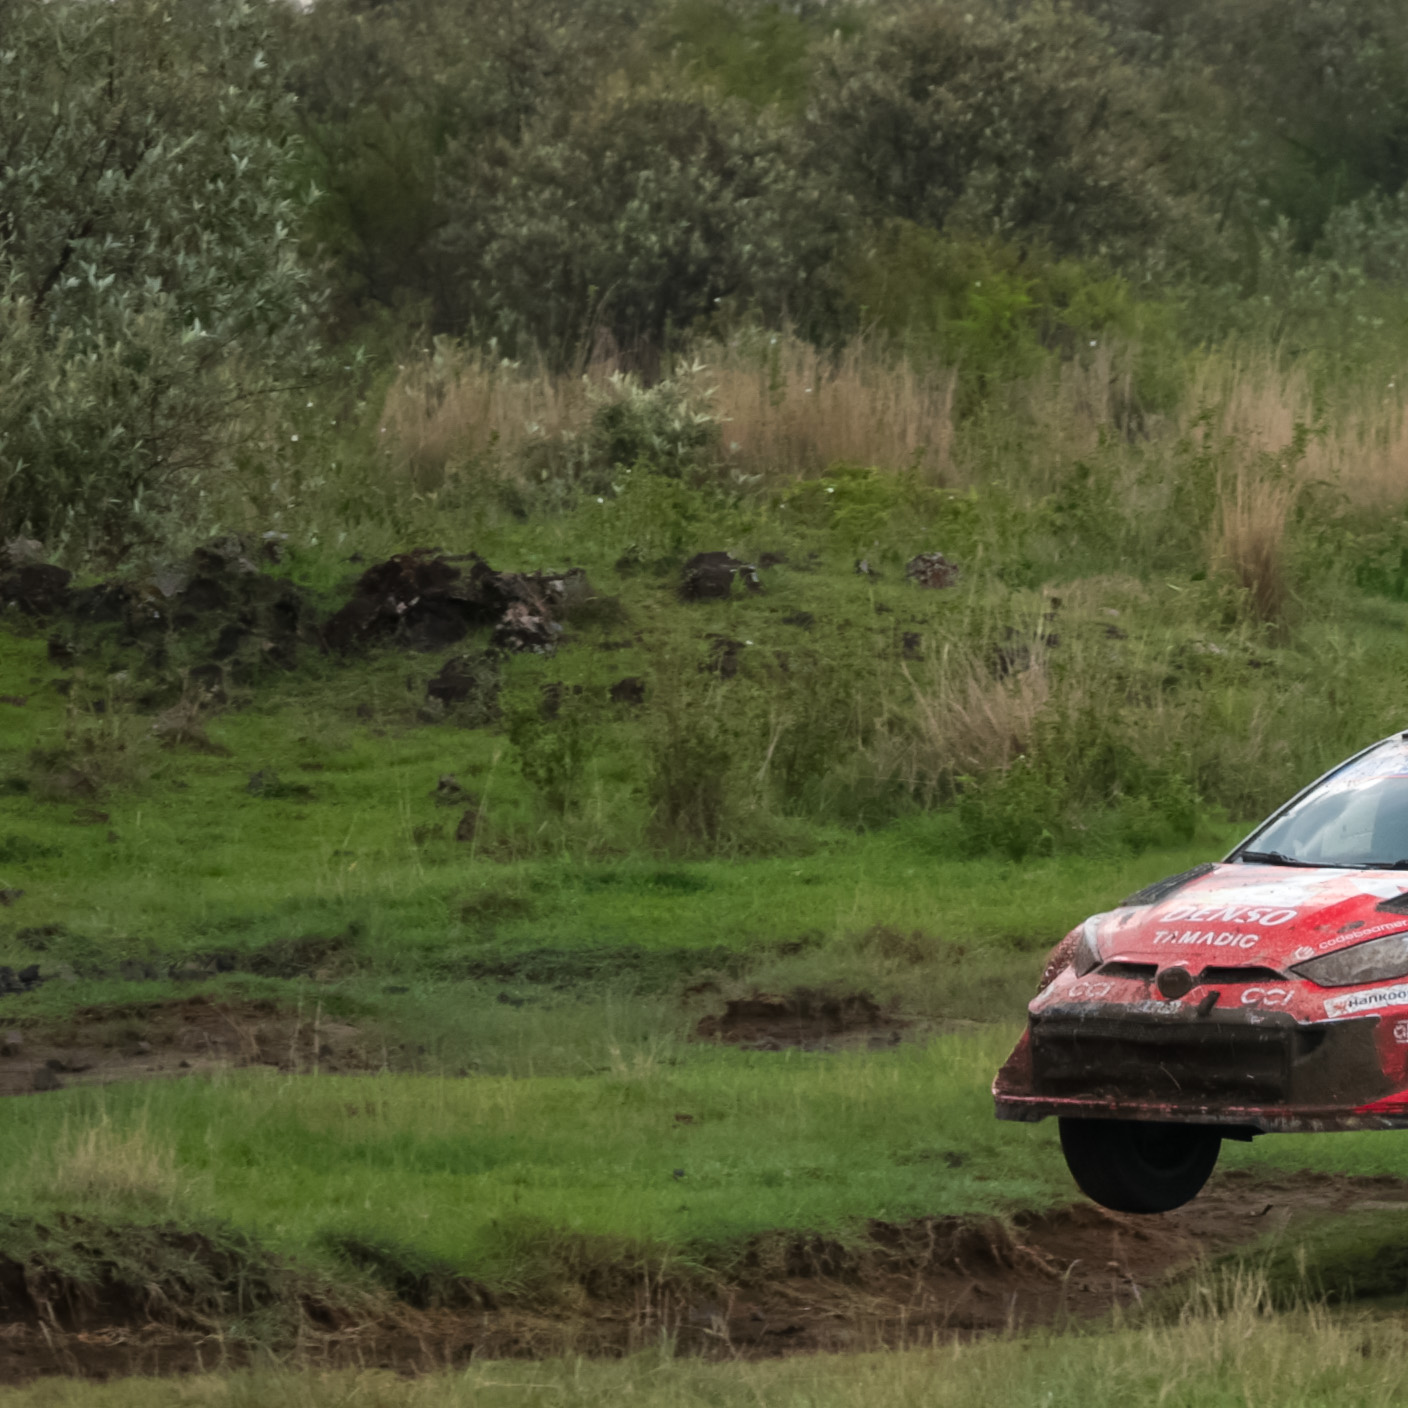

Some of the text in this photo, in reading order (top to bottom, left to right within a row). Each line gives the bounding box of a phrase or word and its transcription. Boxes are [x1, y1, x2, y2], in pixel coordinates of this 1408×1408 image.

[1159, 906, 1298, 927] DENSO
[1152, 930, 1261, 949] TAMADIC
[1240, 986, 1296, 1006] CCI
